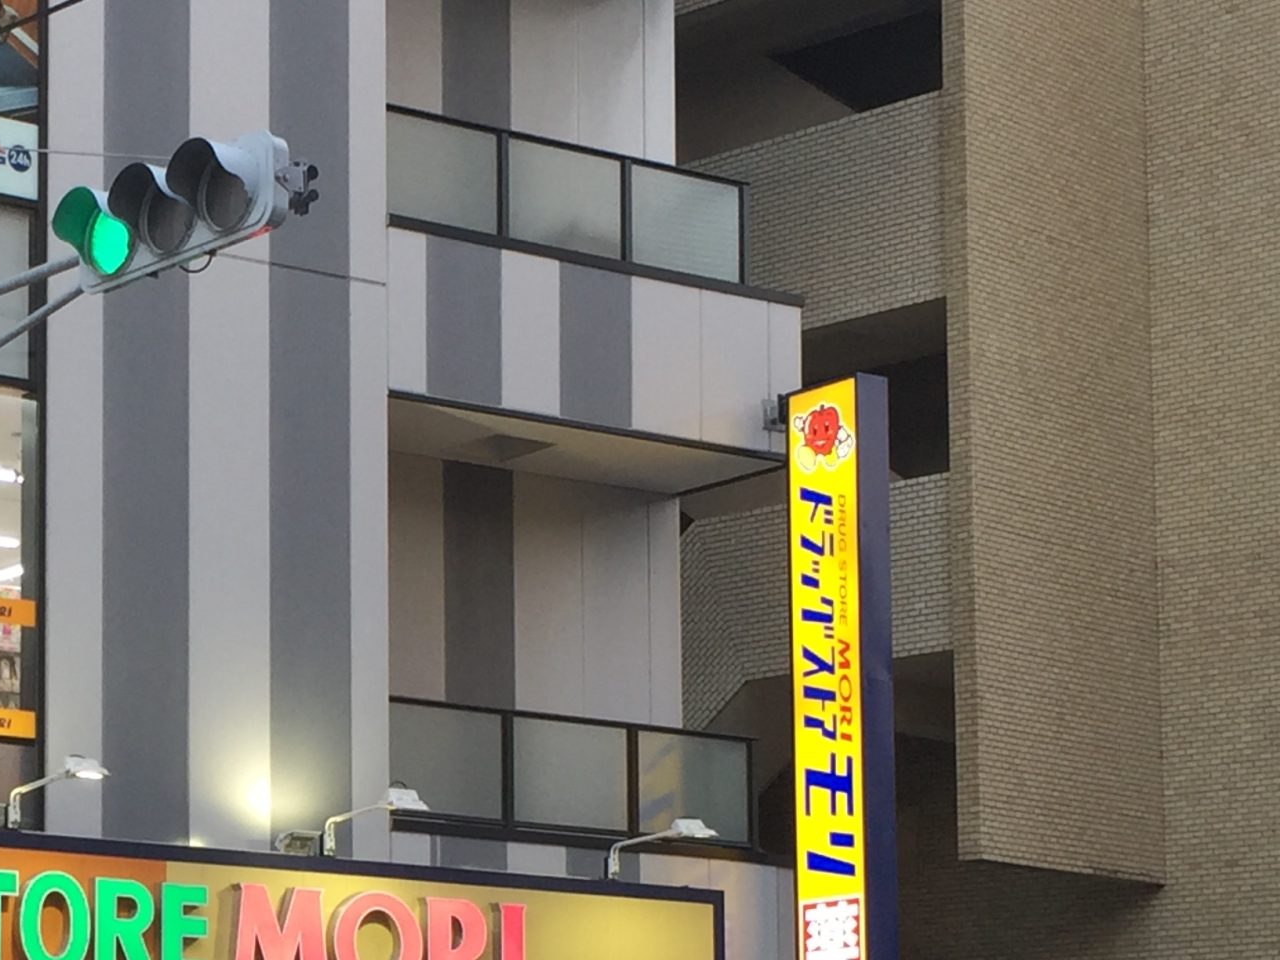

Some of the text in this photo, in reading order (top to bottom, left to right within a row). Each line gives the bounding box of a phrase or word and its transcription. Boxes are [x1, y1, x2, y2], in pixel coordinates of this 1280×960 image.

[836, 494, 852, 742] DRUG STORE MORI
